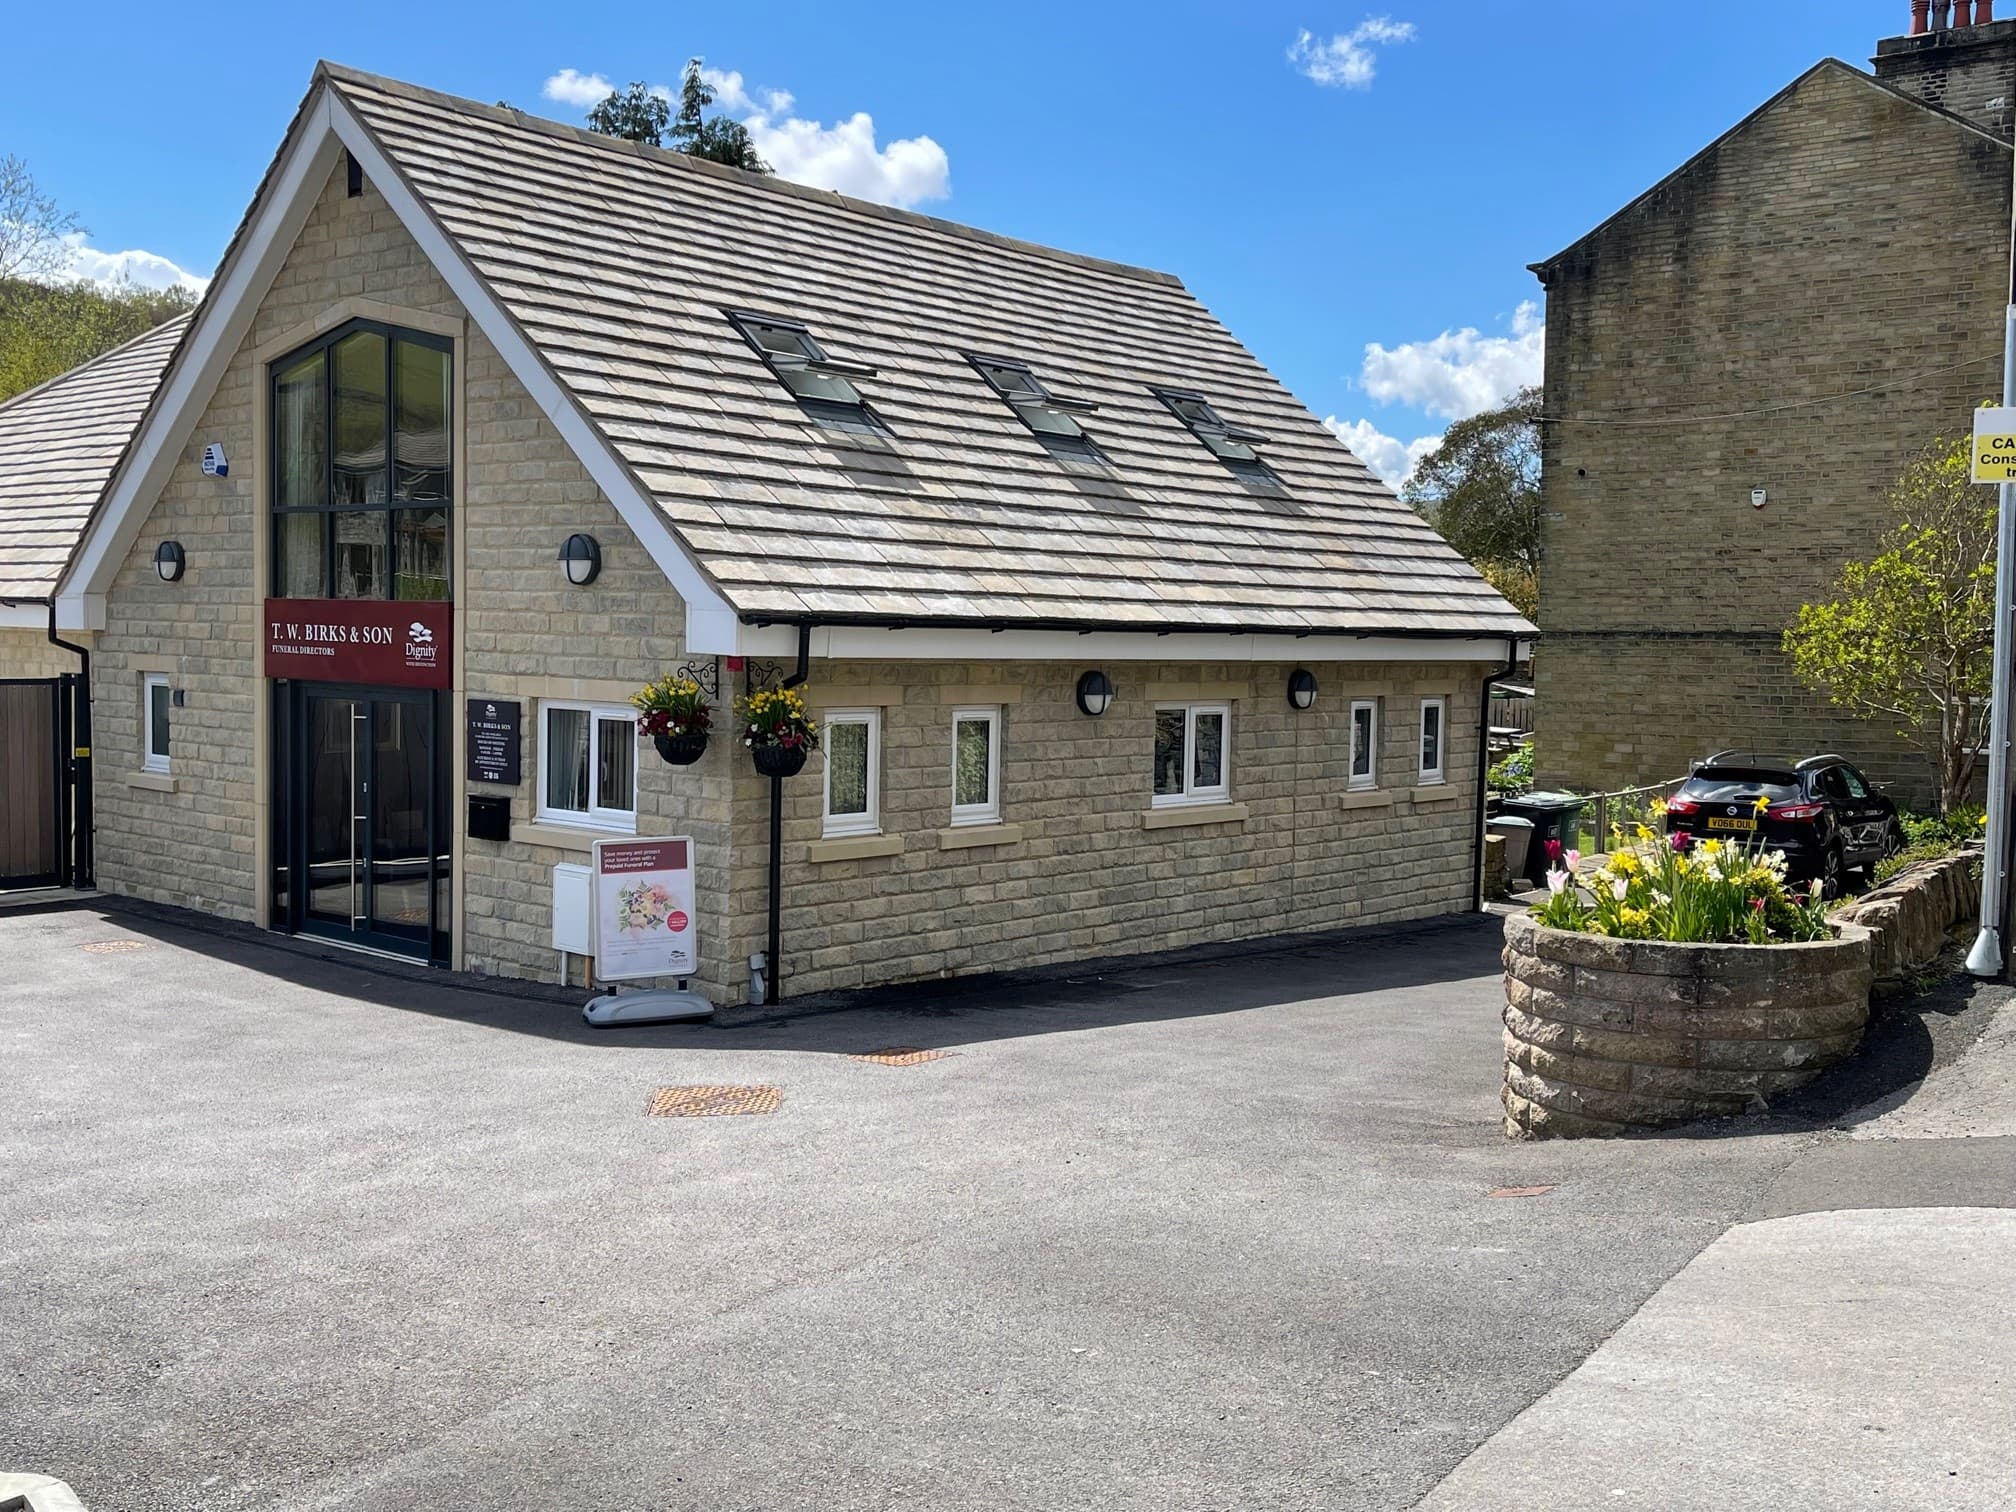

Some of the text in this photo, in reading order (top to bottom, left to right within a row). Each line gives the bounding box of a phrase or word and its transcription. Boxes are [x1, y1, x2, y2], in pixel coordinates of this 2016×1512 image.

[272, 623, 393, 644] T. W. BIRKS & SON
[272, 645, 335, 656] FUNERAL DIRECTORS
[405, 643, 437, 661] Dignity
